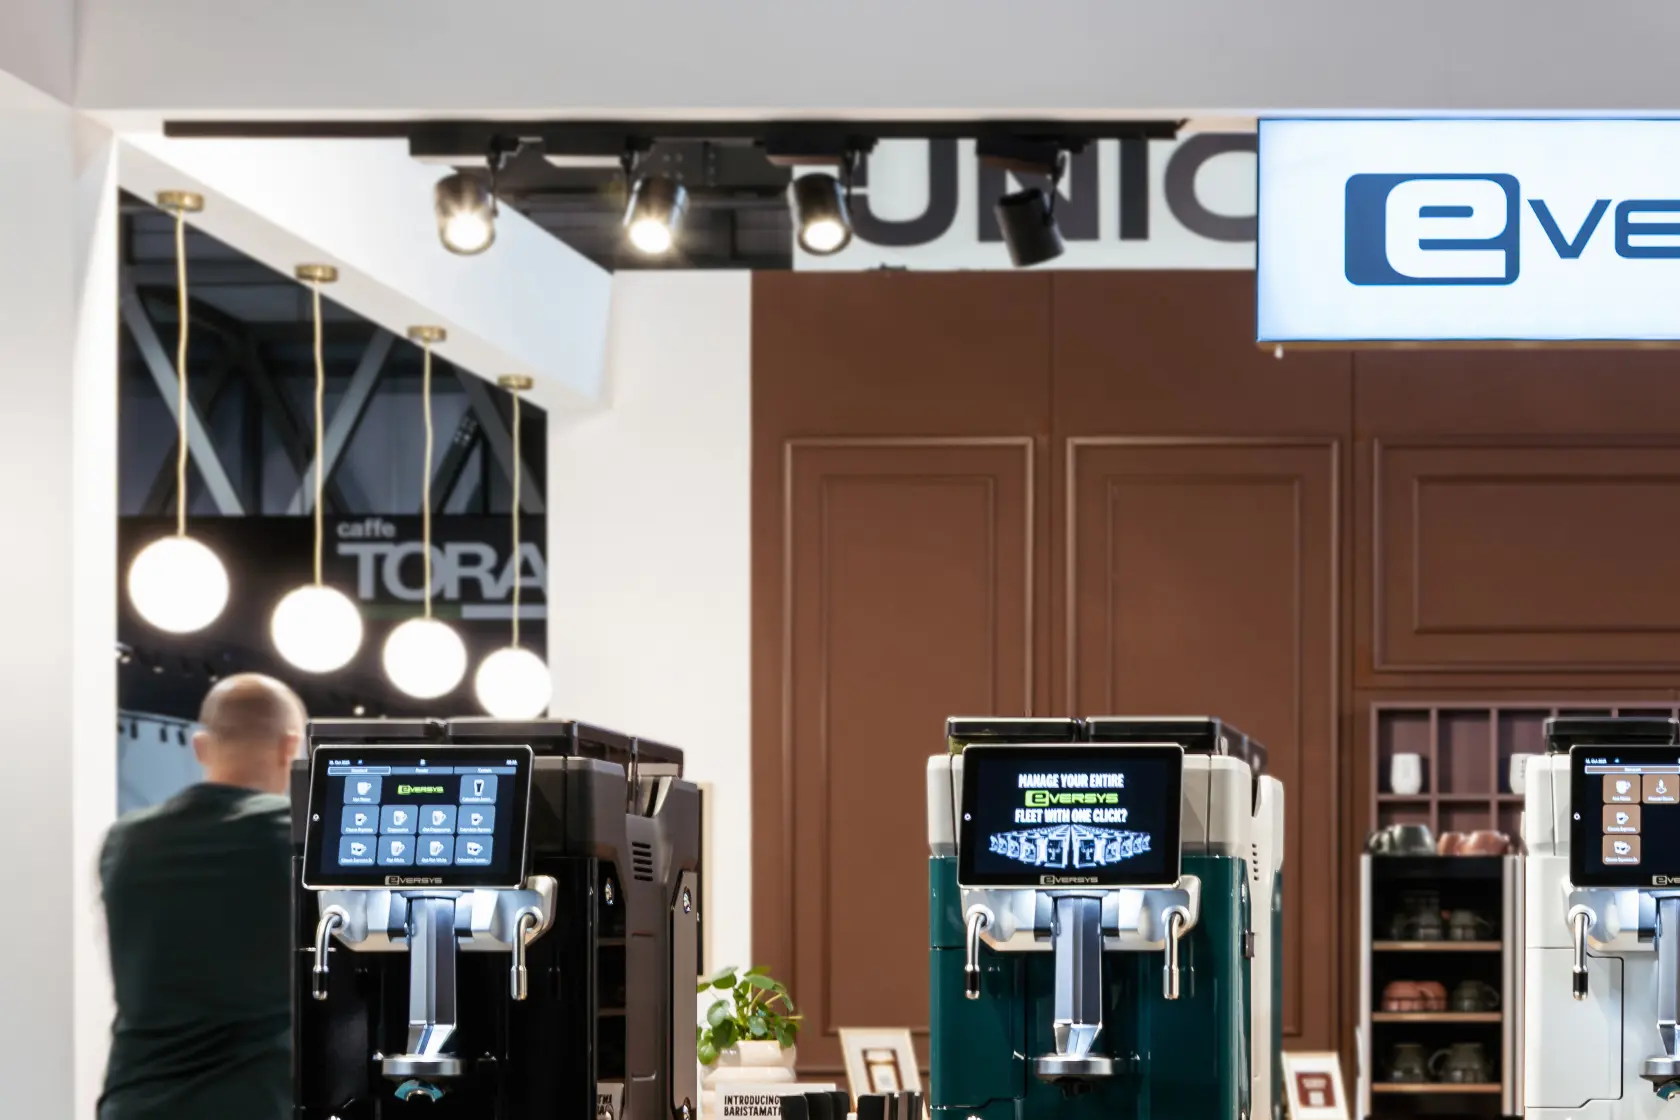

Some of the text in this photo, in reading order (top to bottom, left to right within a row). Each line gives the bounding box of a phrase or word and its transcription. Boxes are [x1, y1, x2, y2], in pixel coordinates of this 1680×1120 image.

[337, 518, 396, 538] caffe
[1018, 773, 1125, 788] MANAGE YOUR ENTIRE
[1014, 808, 1128, 823] FLEET WITH ONE CLICK?
